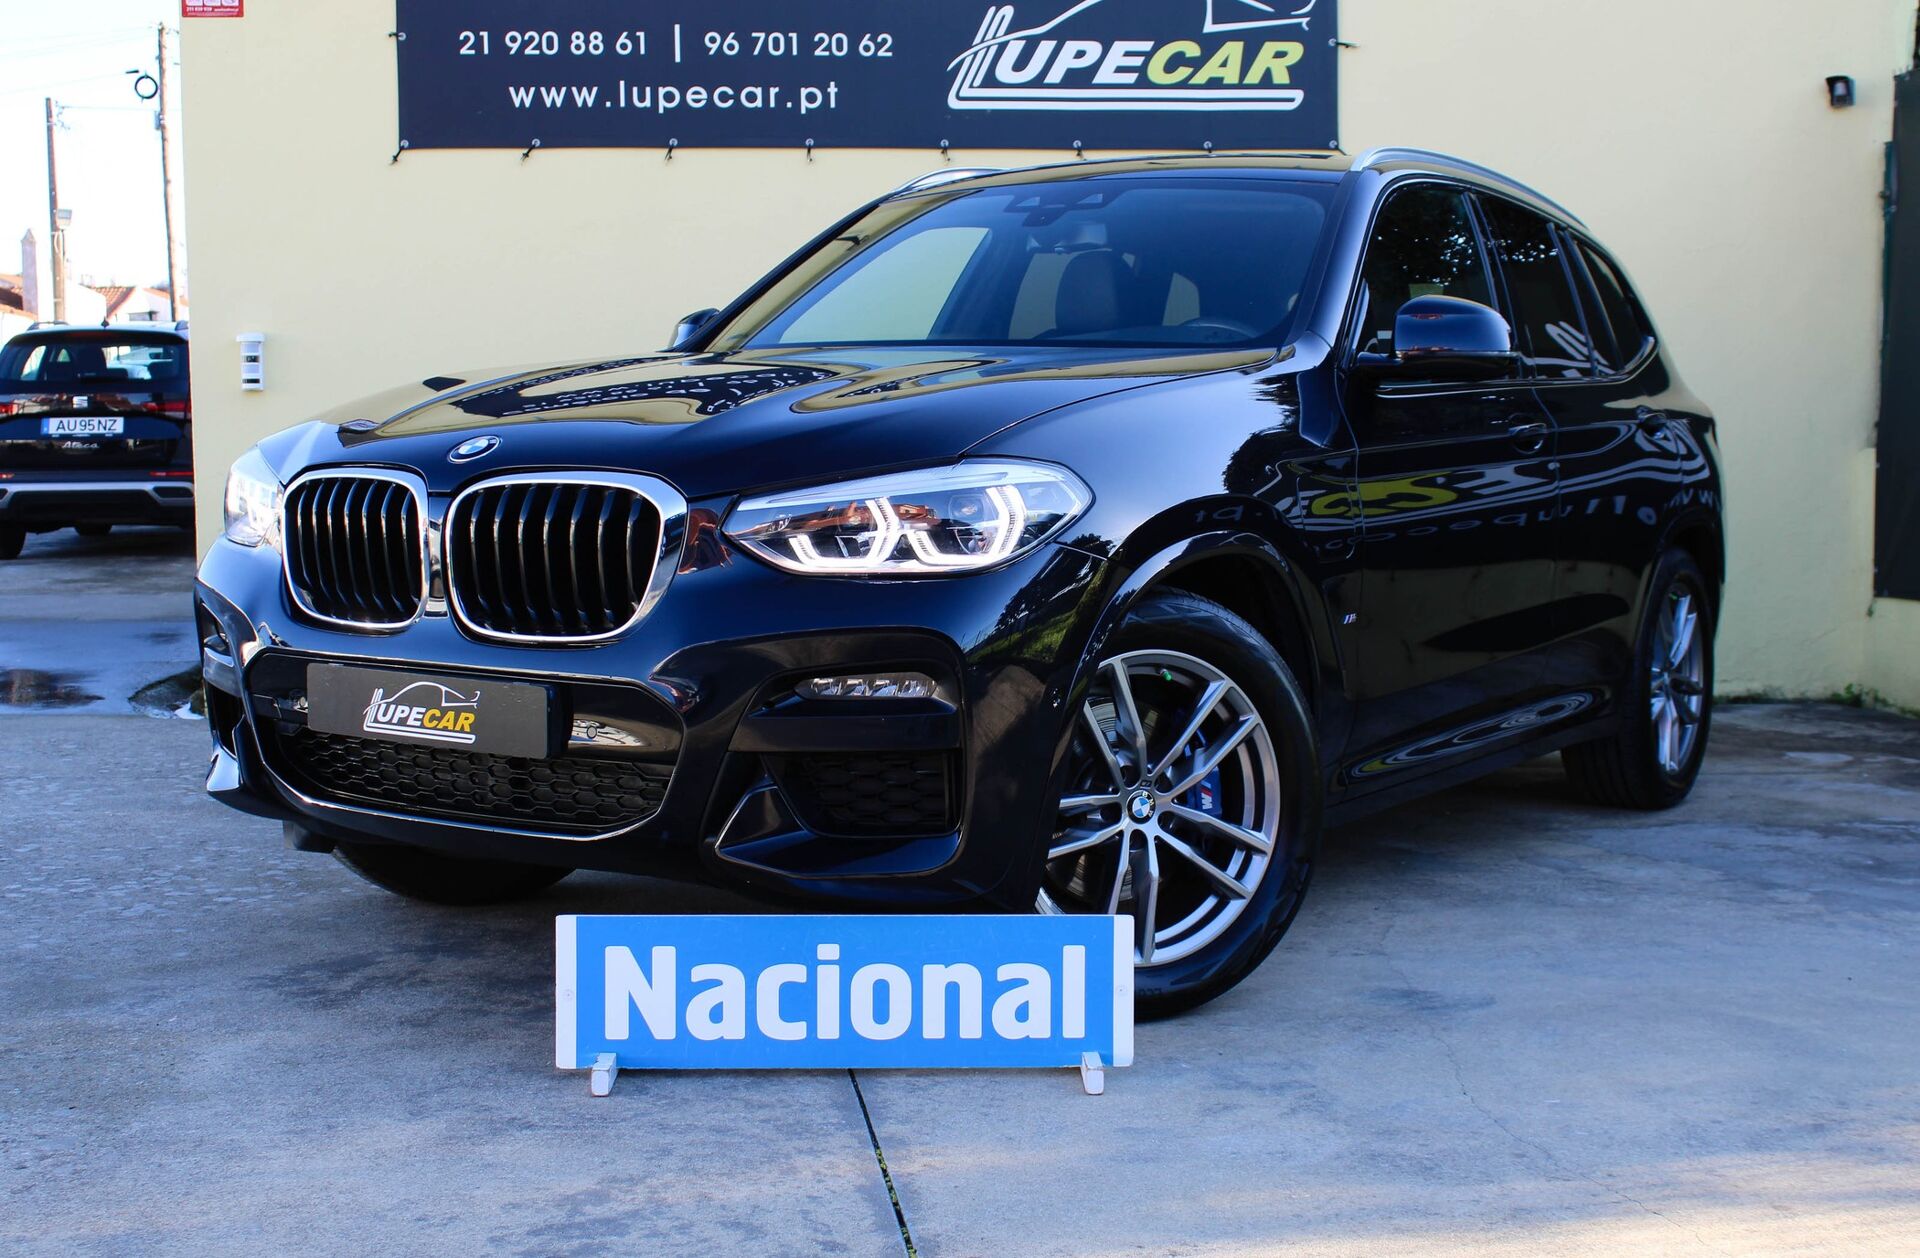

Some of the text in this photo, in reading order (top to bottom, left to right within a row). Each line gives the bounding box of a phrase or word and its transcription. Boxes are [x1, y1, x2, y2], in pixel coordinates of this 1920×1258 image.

[459, 31, 893, 57] 21 920 88 61 96 701 20 62
[947, 5, 1305, 110] LUPECAR
[508, 80, 839, 115] www.lupecar.pt
[363, 688, 476, 744] LUPECAR
[604, 943, 1086, 1041] Nacional
